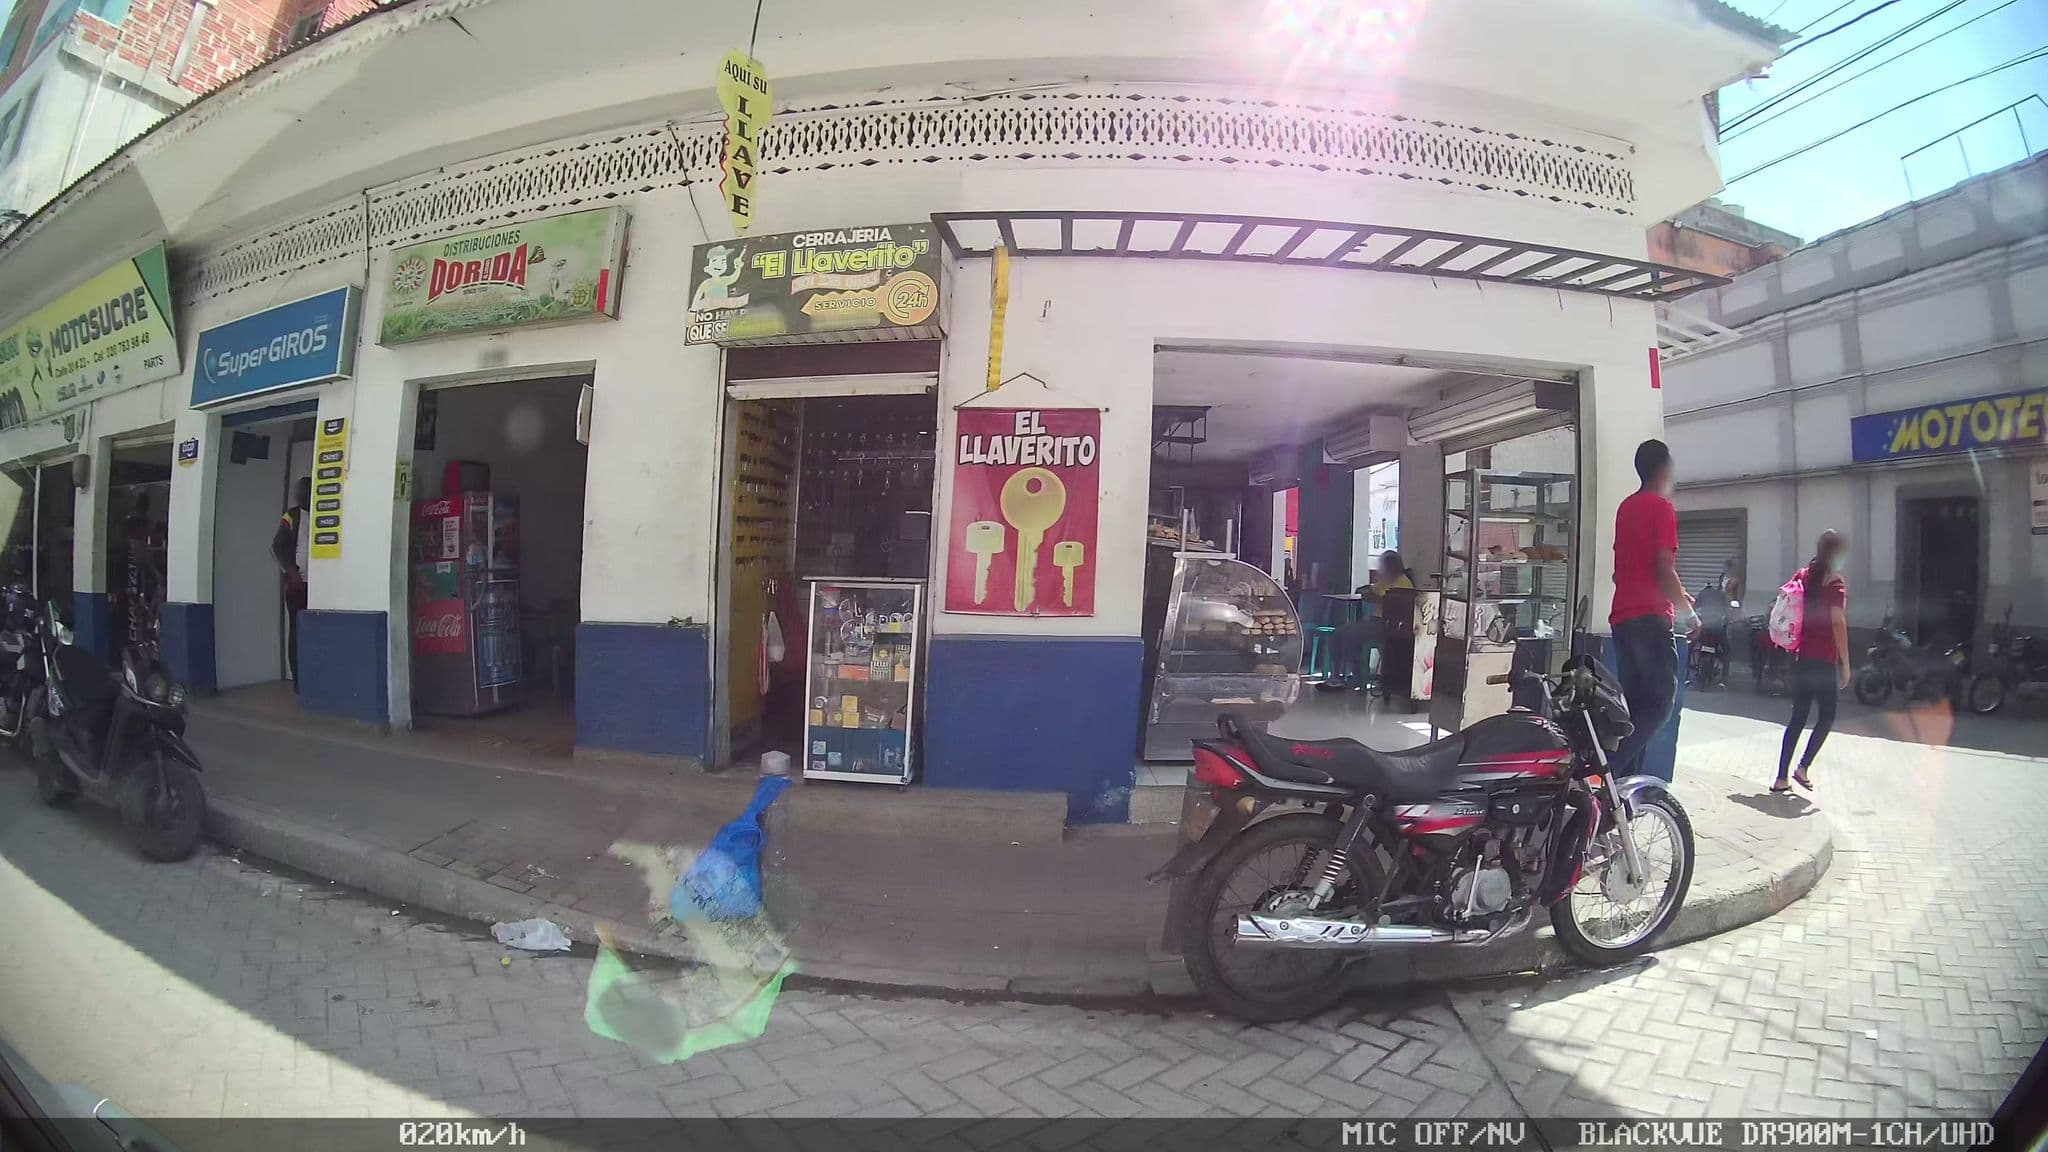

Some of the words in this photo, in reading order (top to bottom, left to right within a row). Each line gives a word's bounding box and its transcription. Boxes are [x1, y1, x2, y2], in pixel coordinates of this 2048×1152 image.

[724, 59, 751, 85] AQUI
[753, 76, 768, 96] SU
[731, 94, 754, 217] LLAVE
[443, 229, 521, 258] DISTRIBUCIONES
[792, 227, 892, 248] CERRAJERIA
[428, 242, 528, 301] DORIDA
[695, 313, 713, 323] NO
[814, 297, 877, 311] SERVICIO
[49, 285, 149, 358] MOTOSUCRE
[689, 323, 713, 341] QUE
[143, 354, 165, 370] PARTS
[217, 324, 329, 377] SuperGIROS
[1015, 410, 1046, 436] EL
[1890, 393, 2048, 453] MOTOTE
[958, 435, 1097, 467] LLAVERITO
